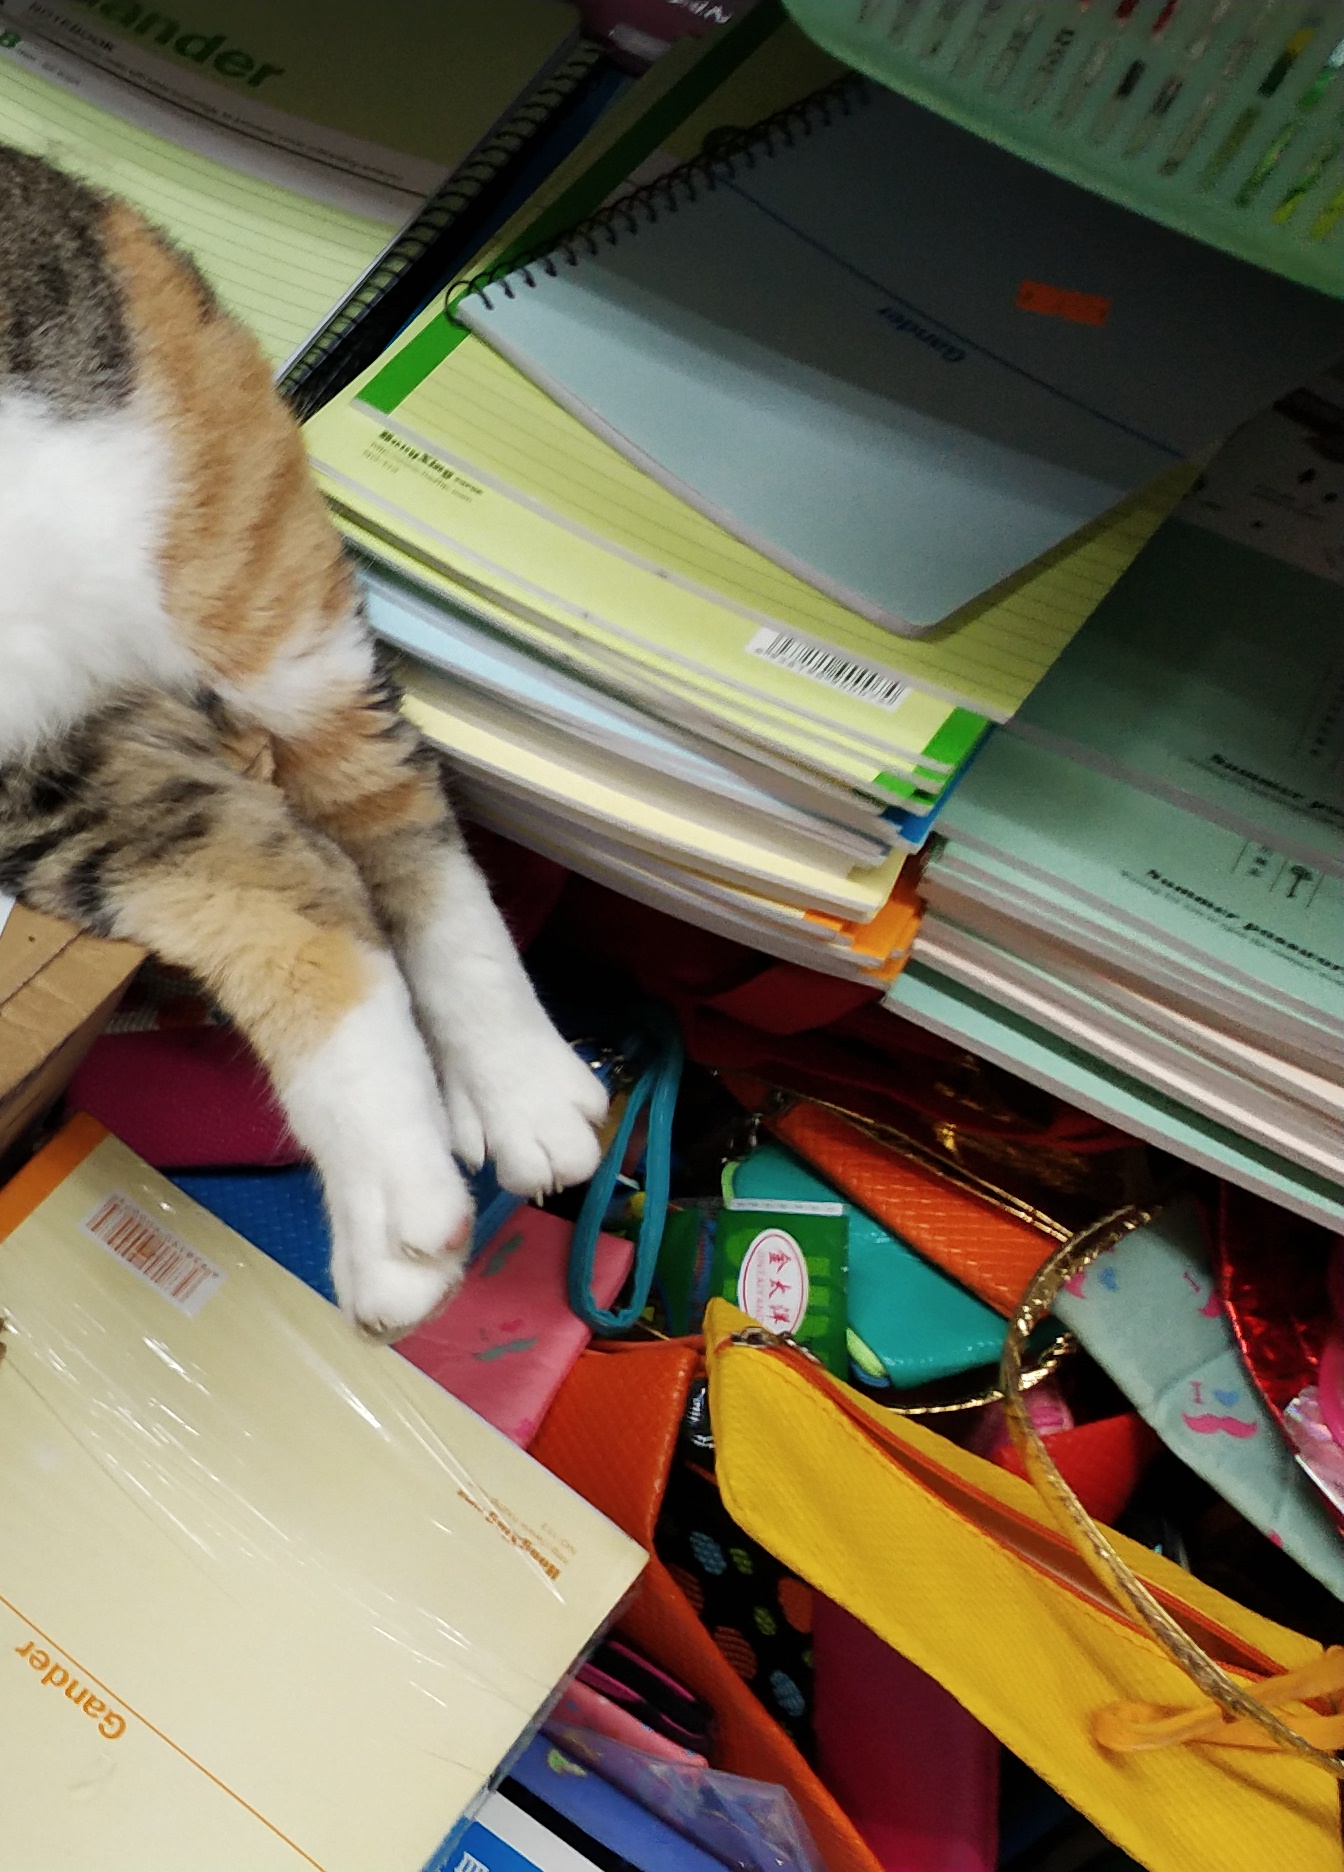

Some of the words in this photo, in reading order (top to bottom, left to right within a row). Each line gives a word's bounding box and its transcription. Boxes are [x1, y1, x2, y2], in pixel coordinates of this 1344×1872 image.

[80, 0, 286, 87] ander
[877, 305, 966, 362] Gander
[1146, 868, 1241, 919] Summer
[14, 1640, 127, 1740] Gander
